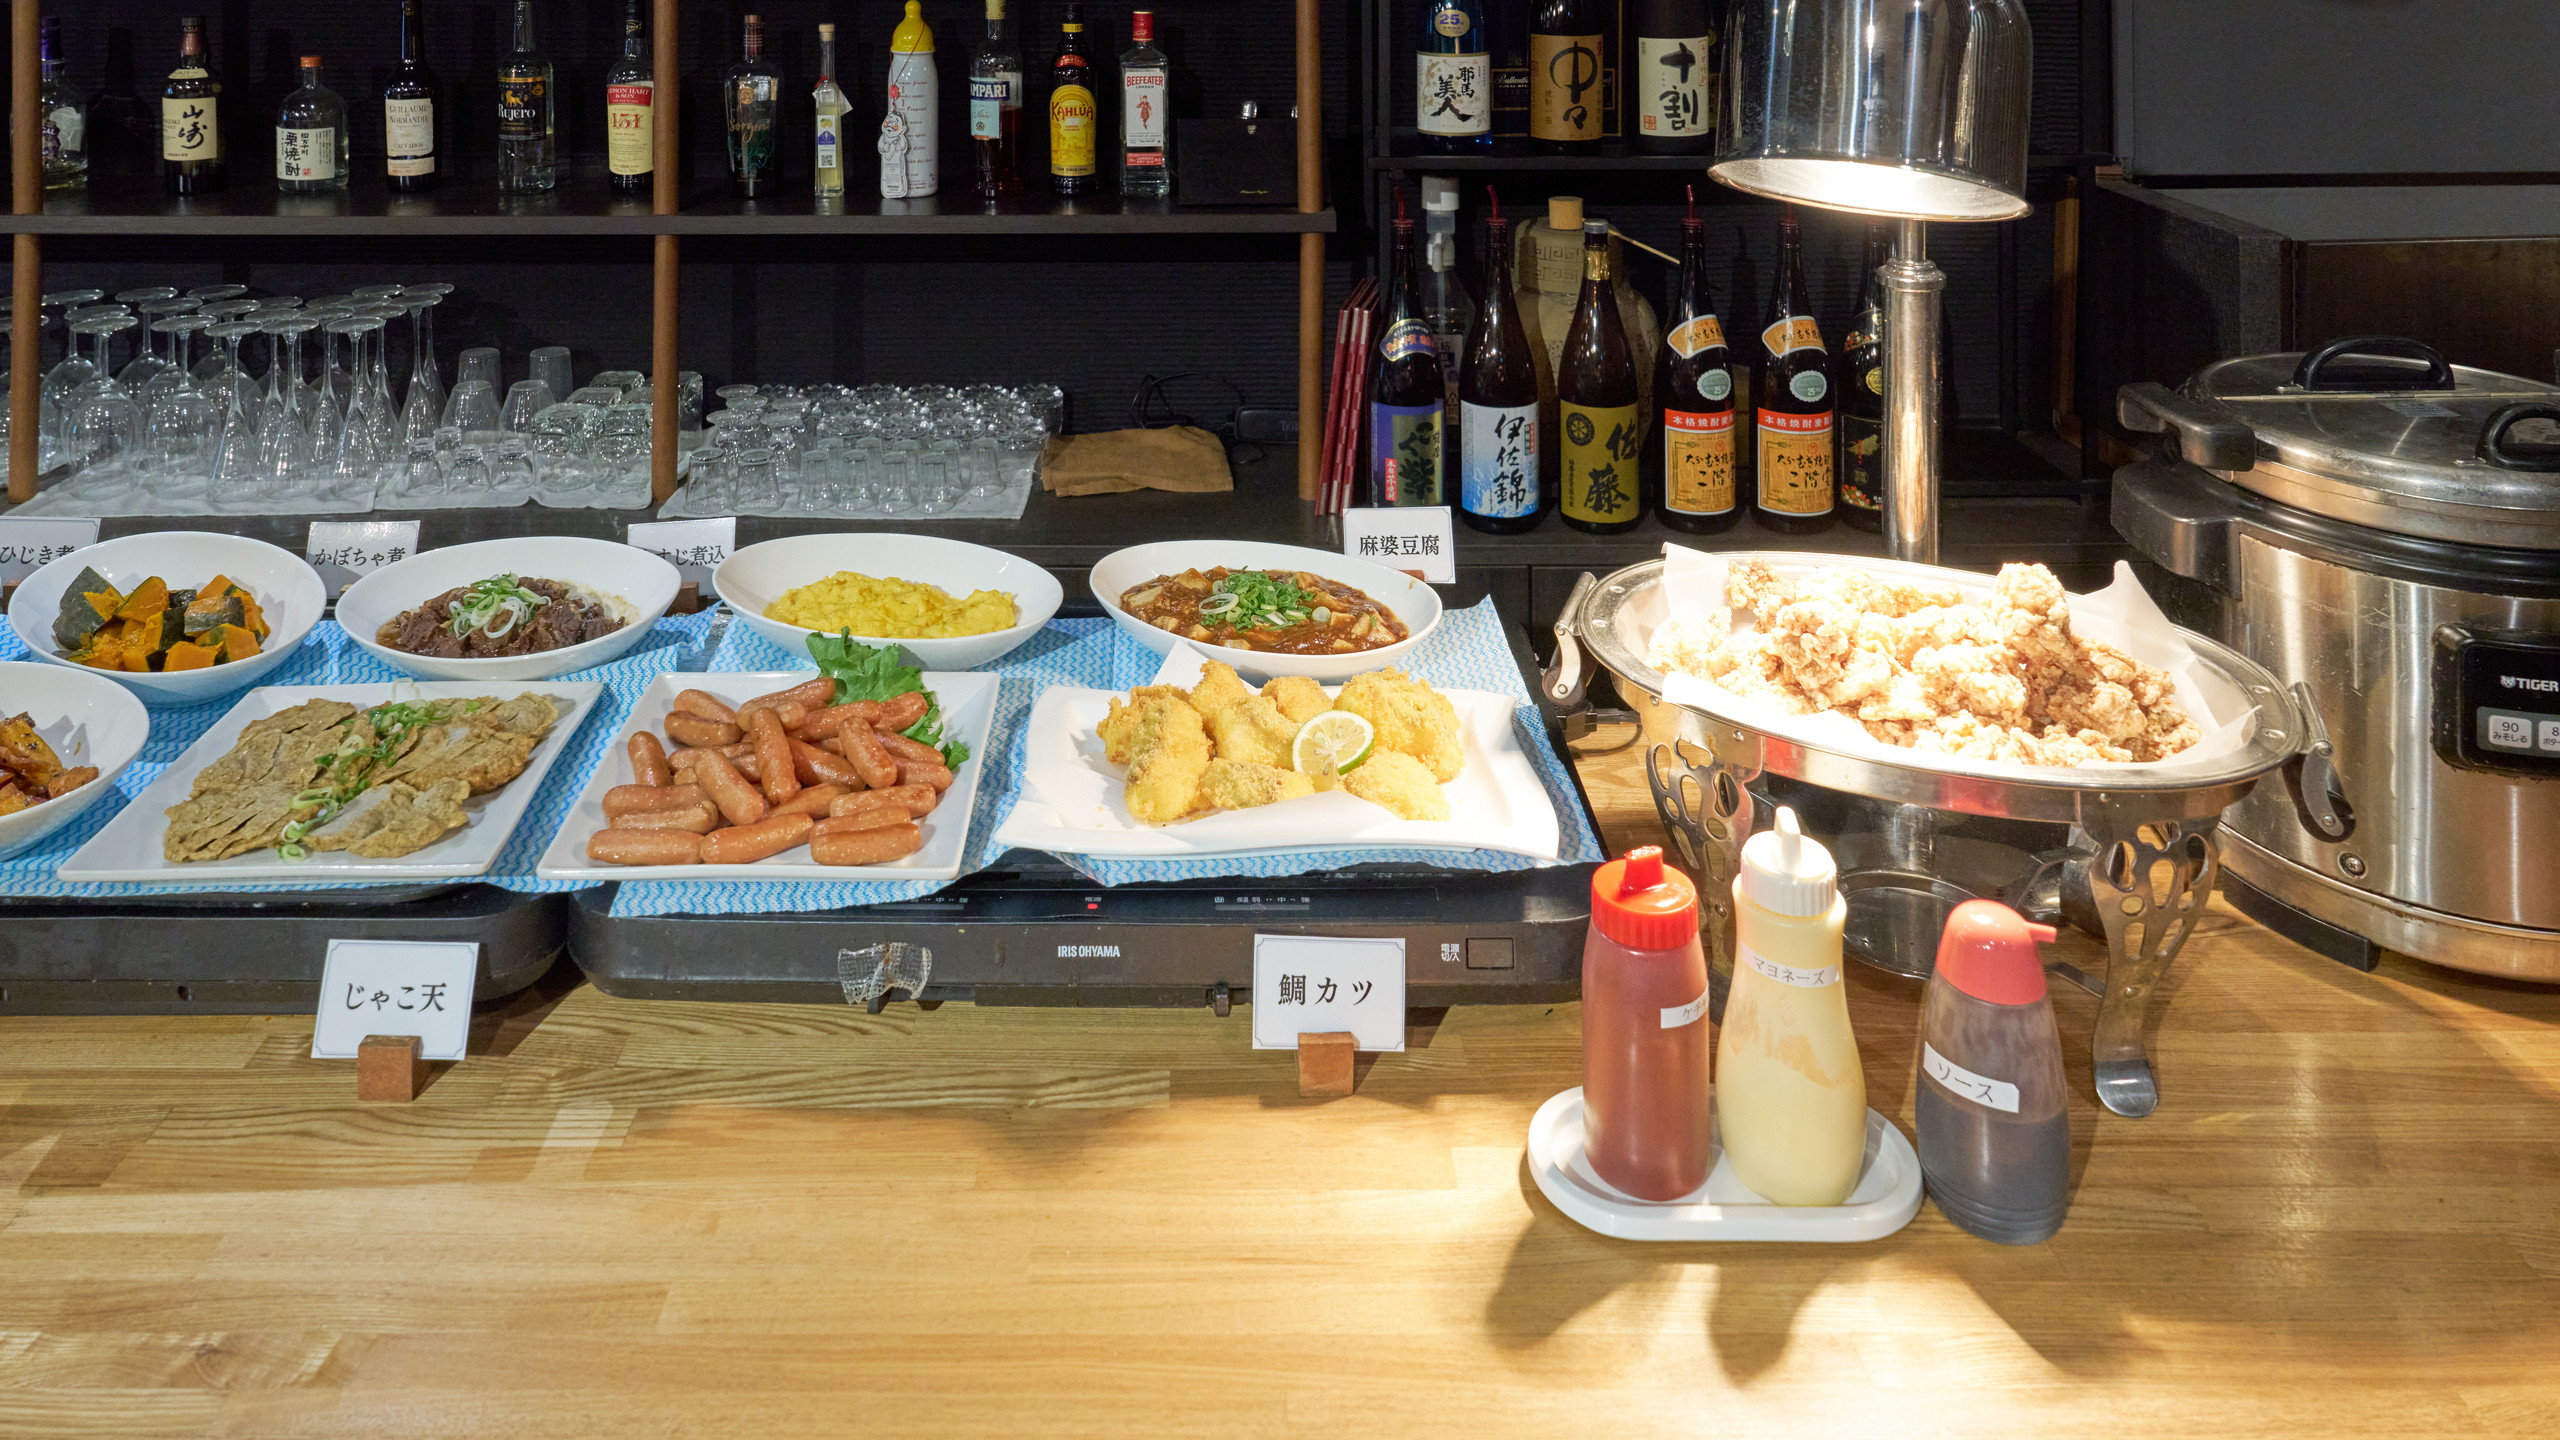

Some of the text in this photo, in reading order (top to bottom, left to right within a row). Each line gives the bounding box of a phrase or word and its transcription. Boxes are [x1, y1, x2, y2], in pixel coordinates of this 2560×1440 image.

[1127, 75, 1163, 87] BEEFEATER
[1549, 41, 1598, 130] 中々
[1659, 41, 1699, 130] 十割
[1052, 101, 1094, 121] KAHLÚA
[285, 131, 301, 176] 栗焼酎
[1493, 412, 1526, 511] 伊佐錦
[1583, 416, 1638, 515] 佐藤
[1359, 535, 1440, 556] 麻婆豆腐
[2515, 677, 2559, 692] TIGER
[2493, 731, 2528, 743] みそしる
[2502, 721, 2519, 733] 90
[1058, 945, 1121, 957] IRIS OHYAMA
[1441, 943, 1460, 953] 電源
[346, 982, 447, 1013] じゃこ天
[1278, 973, 1373, 1006] 鯛カツ
[1938, 1061, 1993, 1103] ソース
